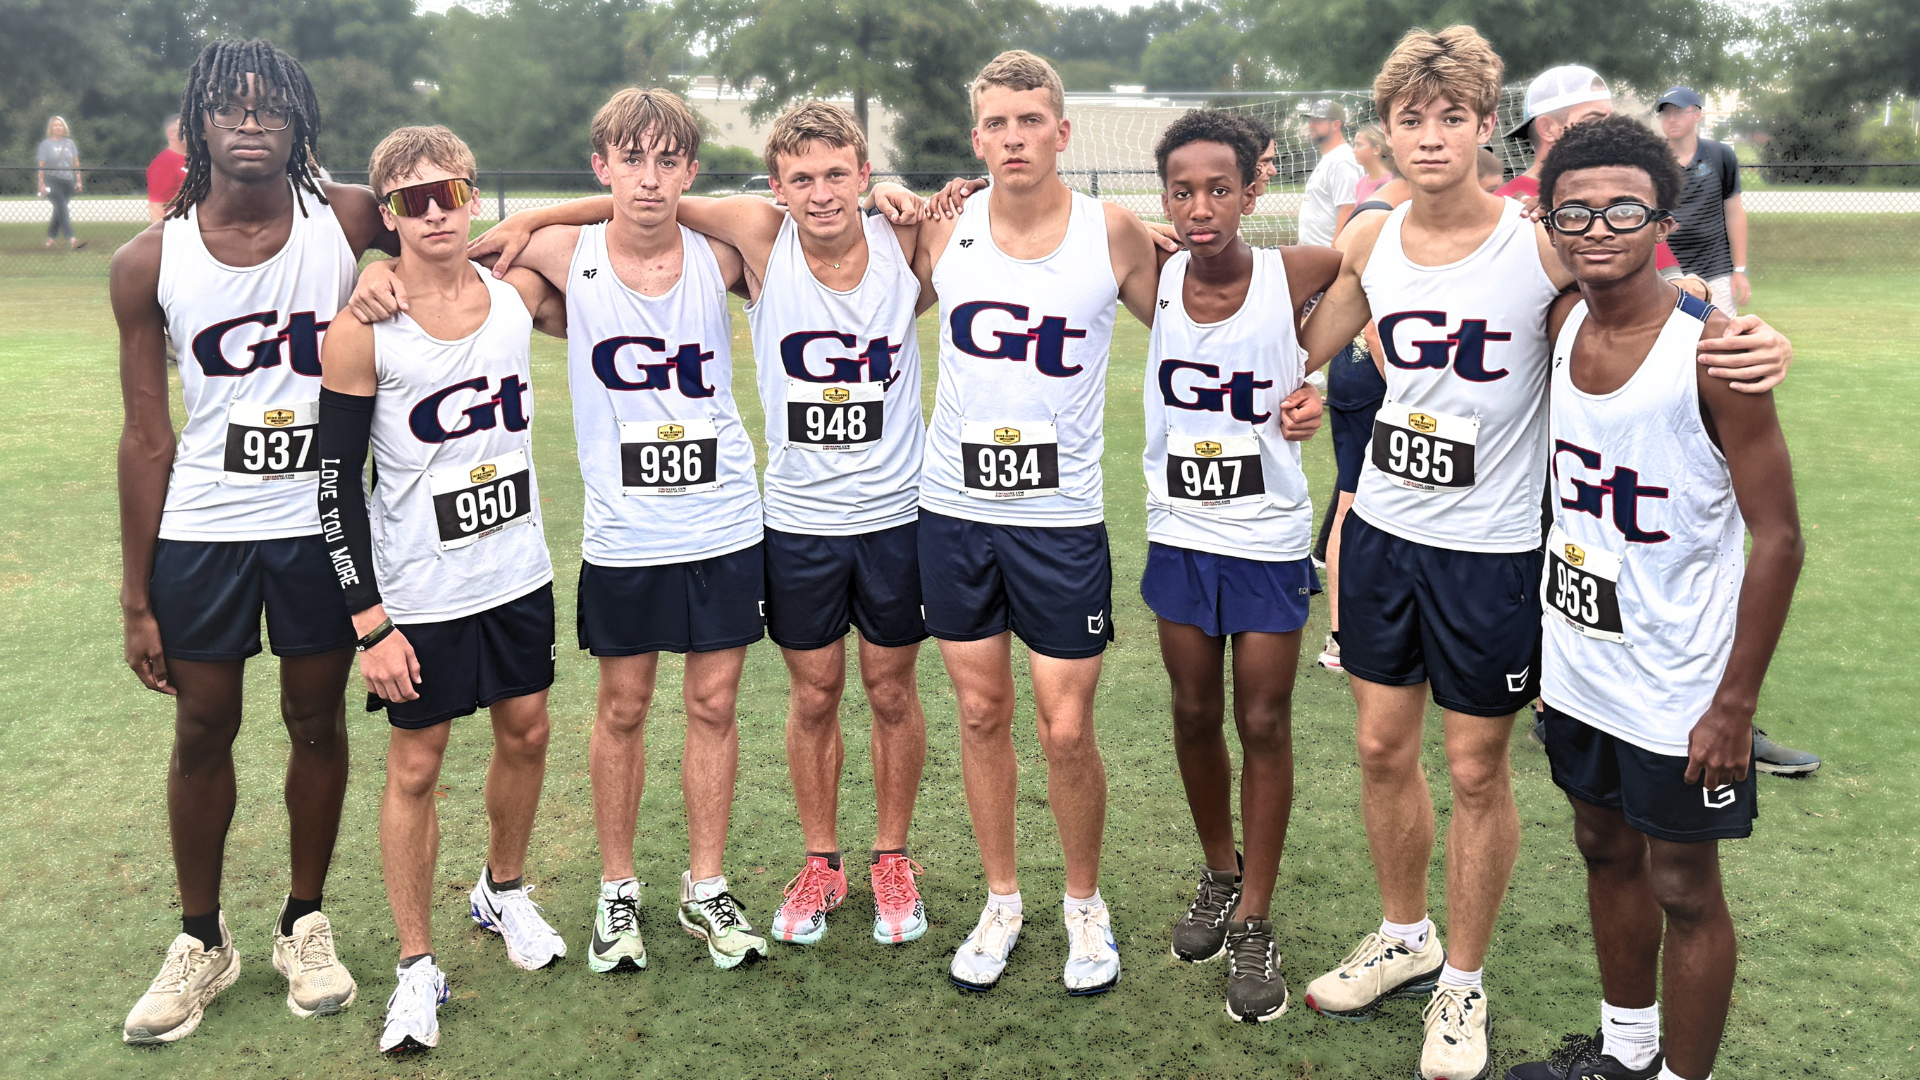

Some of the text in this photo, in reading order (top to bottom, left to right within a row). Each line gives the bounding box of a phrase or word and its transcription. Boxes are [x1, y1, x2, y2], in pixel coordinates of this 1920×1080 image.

[191, 309, 331, 377] Gt
[591, 335, 716, 398] Gt
[779, 330, 902, 392] Gt
[949, 300, 1087, 378] Gt
[1377, 310, 1512, 383] Gt
[408, 374, 530, 444] Gt
[806, 405, 867, 441] 948
[1158, 358, 1273, 425] Gt
[243, 428, 314, 471] 937
[640, 443, 702, 484] 936
[978, 447, 1042, 488] 934
[1180, 459, 1242, 497] 947
[1388, 429, 1454, 484] 935
[455, 479, 517, 532] 950
[1552, 438, 1671, 544] Gt
[320, 458, 360, 590] LOVE YOU MORE
[1555, 561, 1599, 624] 953
